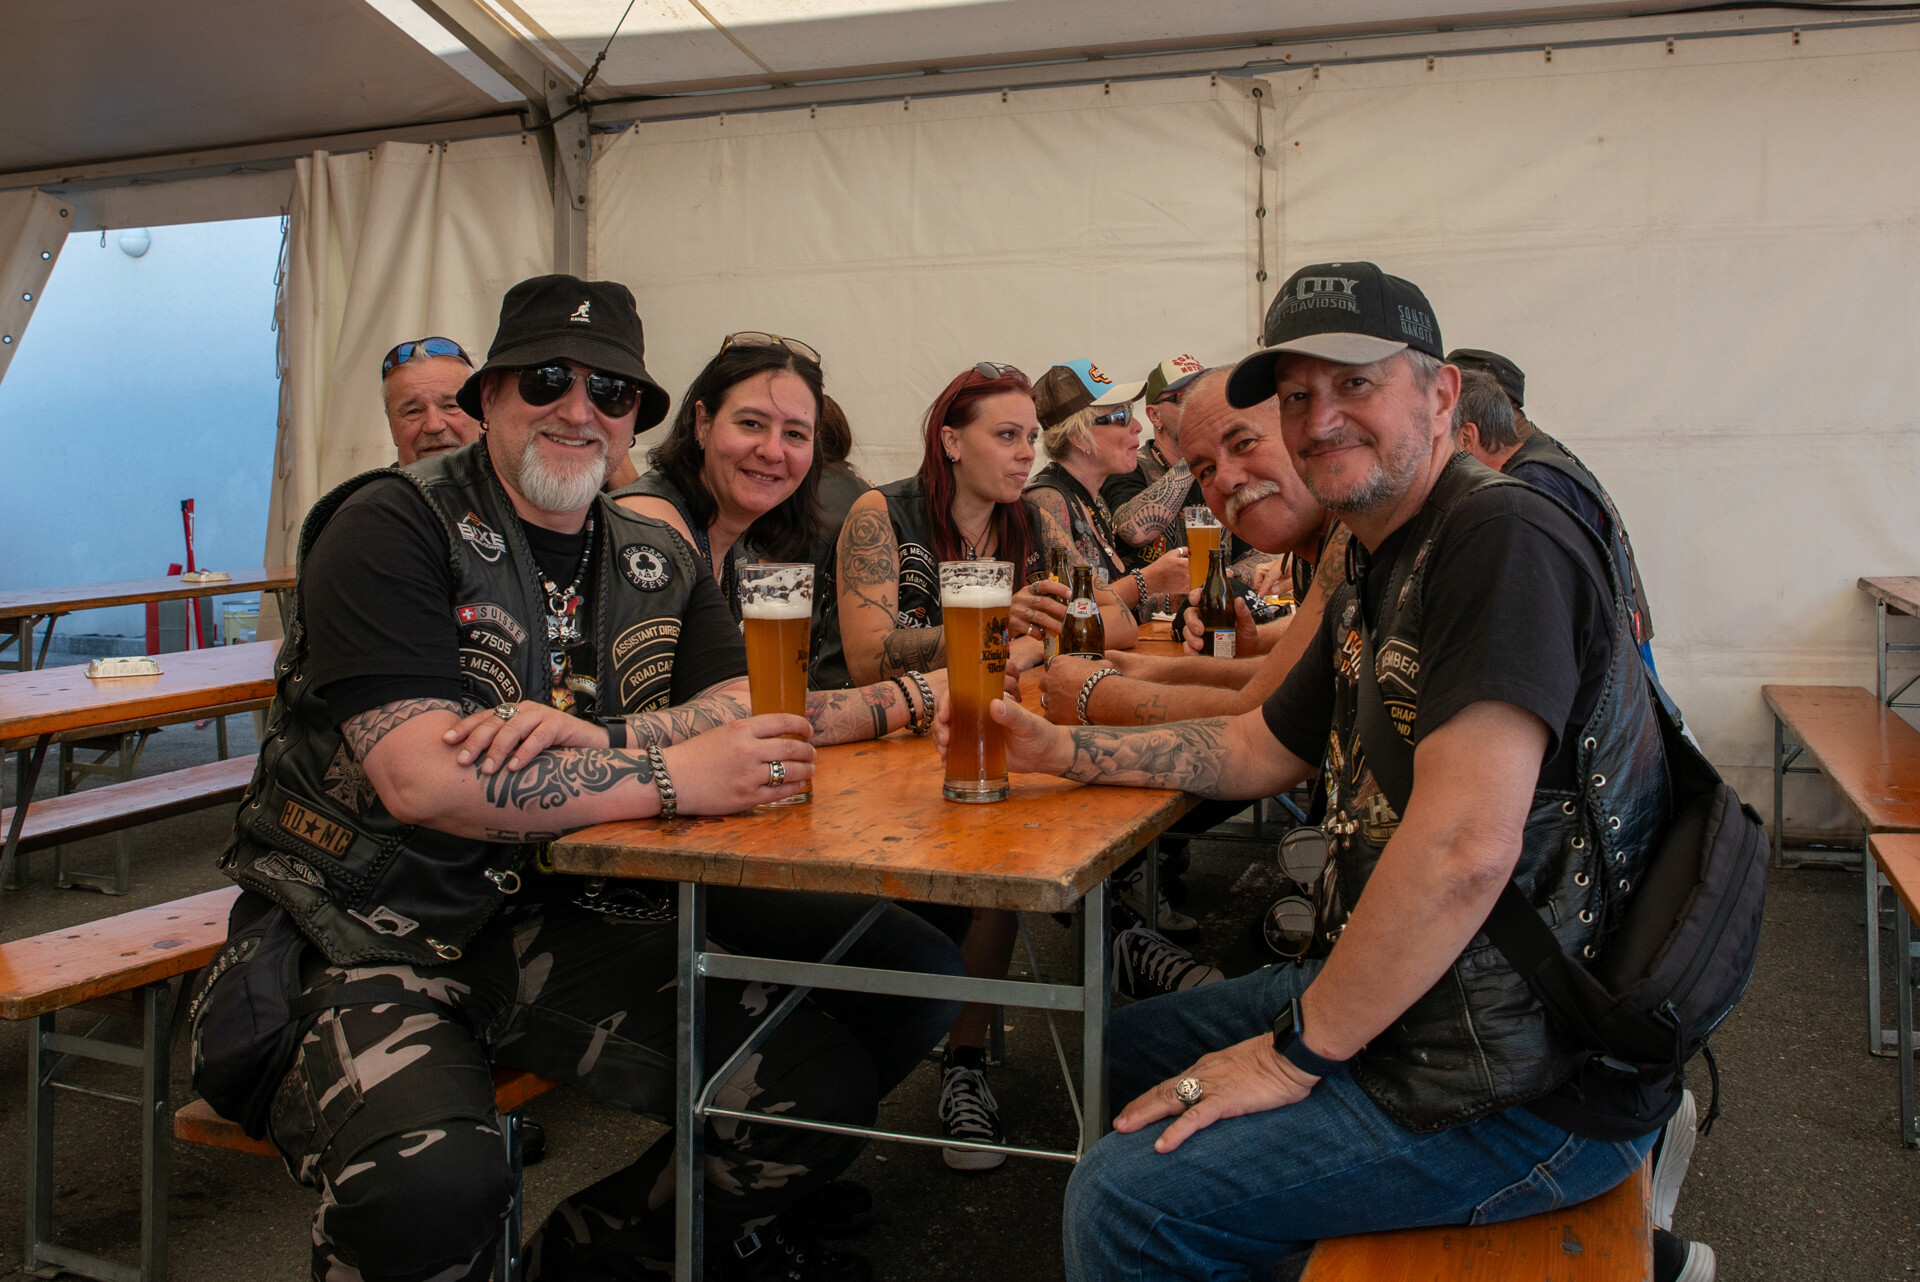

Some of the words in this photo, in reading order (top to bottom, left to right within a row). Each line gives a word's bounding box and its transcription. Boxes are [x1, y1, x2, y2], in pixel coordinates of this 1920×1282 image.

[1296, 276, 1359, 300] CITY
[1397, 304, 1432, 328] SOUTH
[1401, 321, 1434, 345] DAKOTA
[623, 546, 638, 560] ACE
[640, 545, 667, 564] CAFE
[627, 570, 669, 589] LUZERN
[905, 573, 928, 588] Manu
[480, 606, 522, 640] SUISSE
[470, 629, 513, 655] #7505
[615, 626, 658, 657] ASSISTANT
[470, 657, 515, 697] MEMBER
[629, 664, 657, 687] ROAD
[1391, 706, 1417, 722] CHAP
